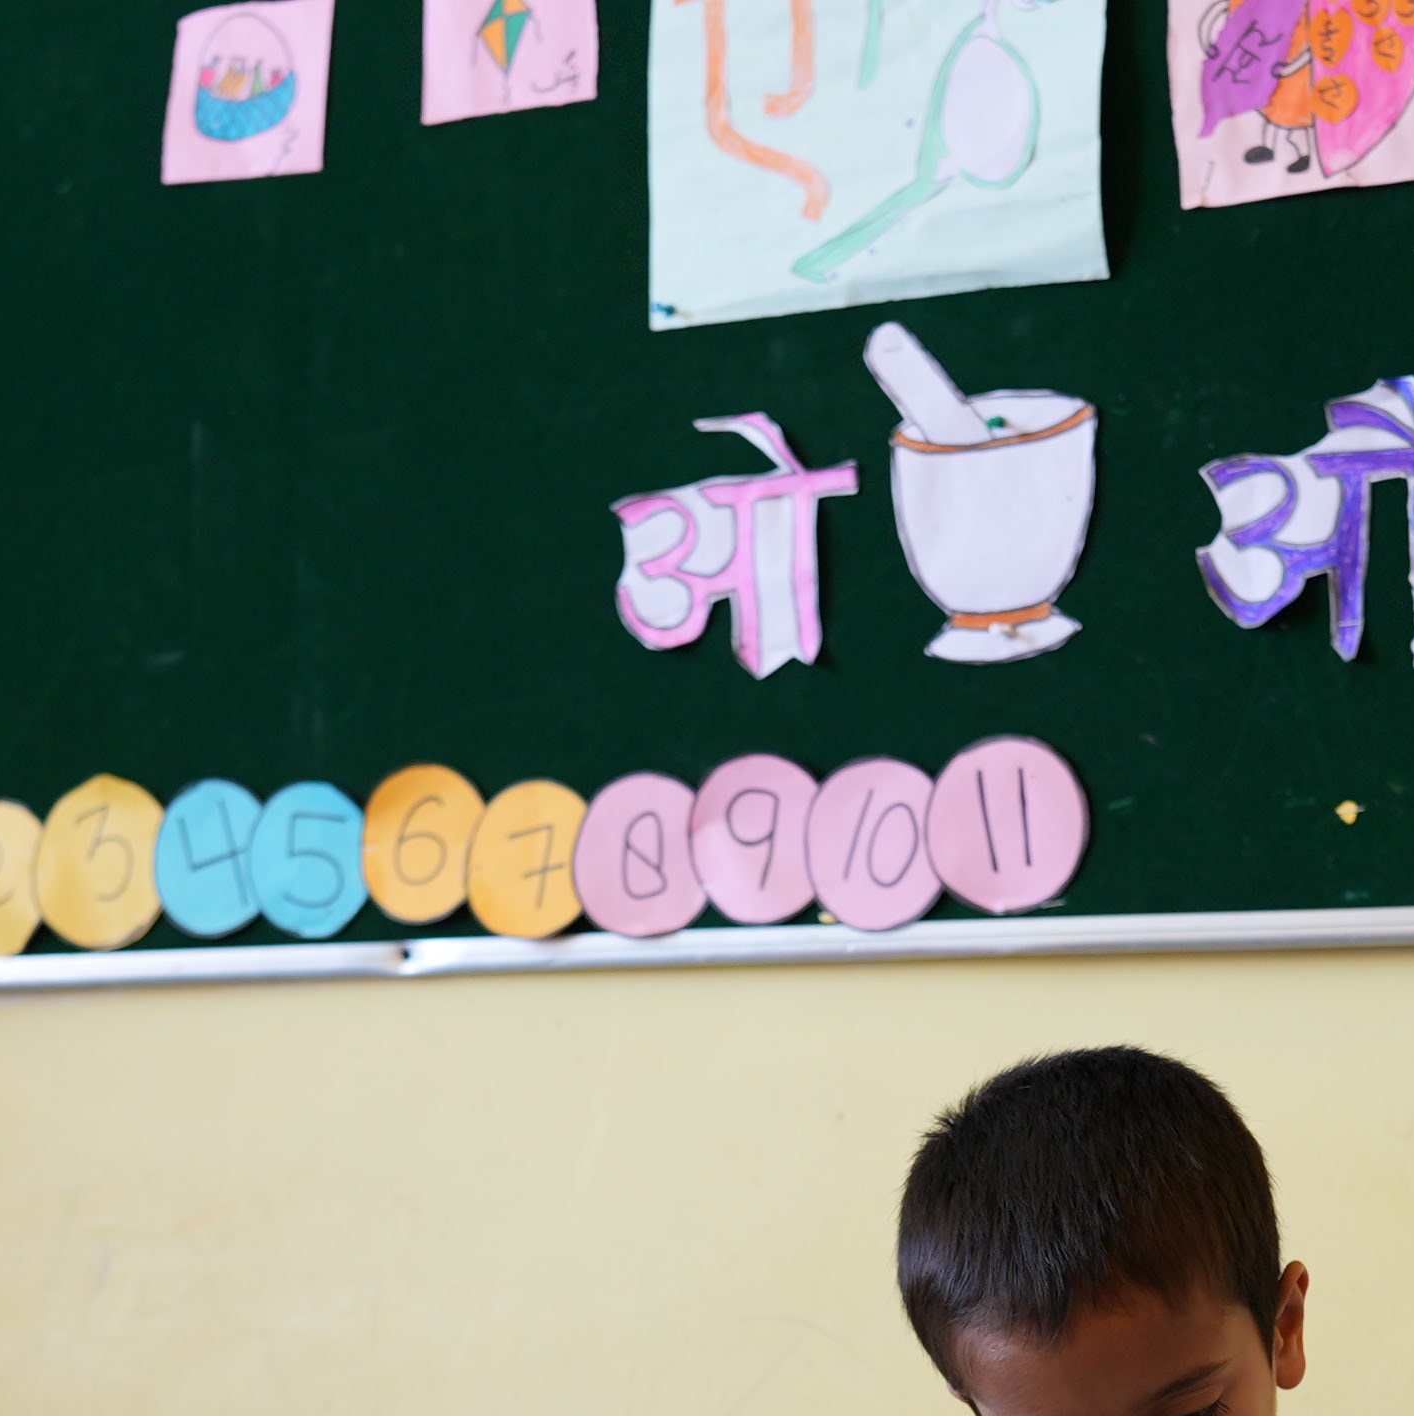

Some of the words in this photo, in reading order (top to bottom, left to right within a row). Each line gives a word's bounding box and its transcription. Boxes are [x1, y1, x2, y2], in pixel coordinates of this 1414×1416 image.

[609, 411, 859, 680] ओ
[75, 804, 135, 902] 3
[176, 795, 251, 909] 4
[282, 810, 347, 909] 5
[393, 793, 447, 887] 6
[506, 822, 564, 910] 7
[619, 810, 669, 900] 8
[724, 787, 782, 890] 9
[842, 787, 919, 889] 10
[976, 765, 1034, 875] 11
